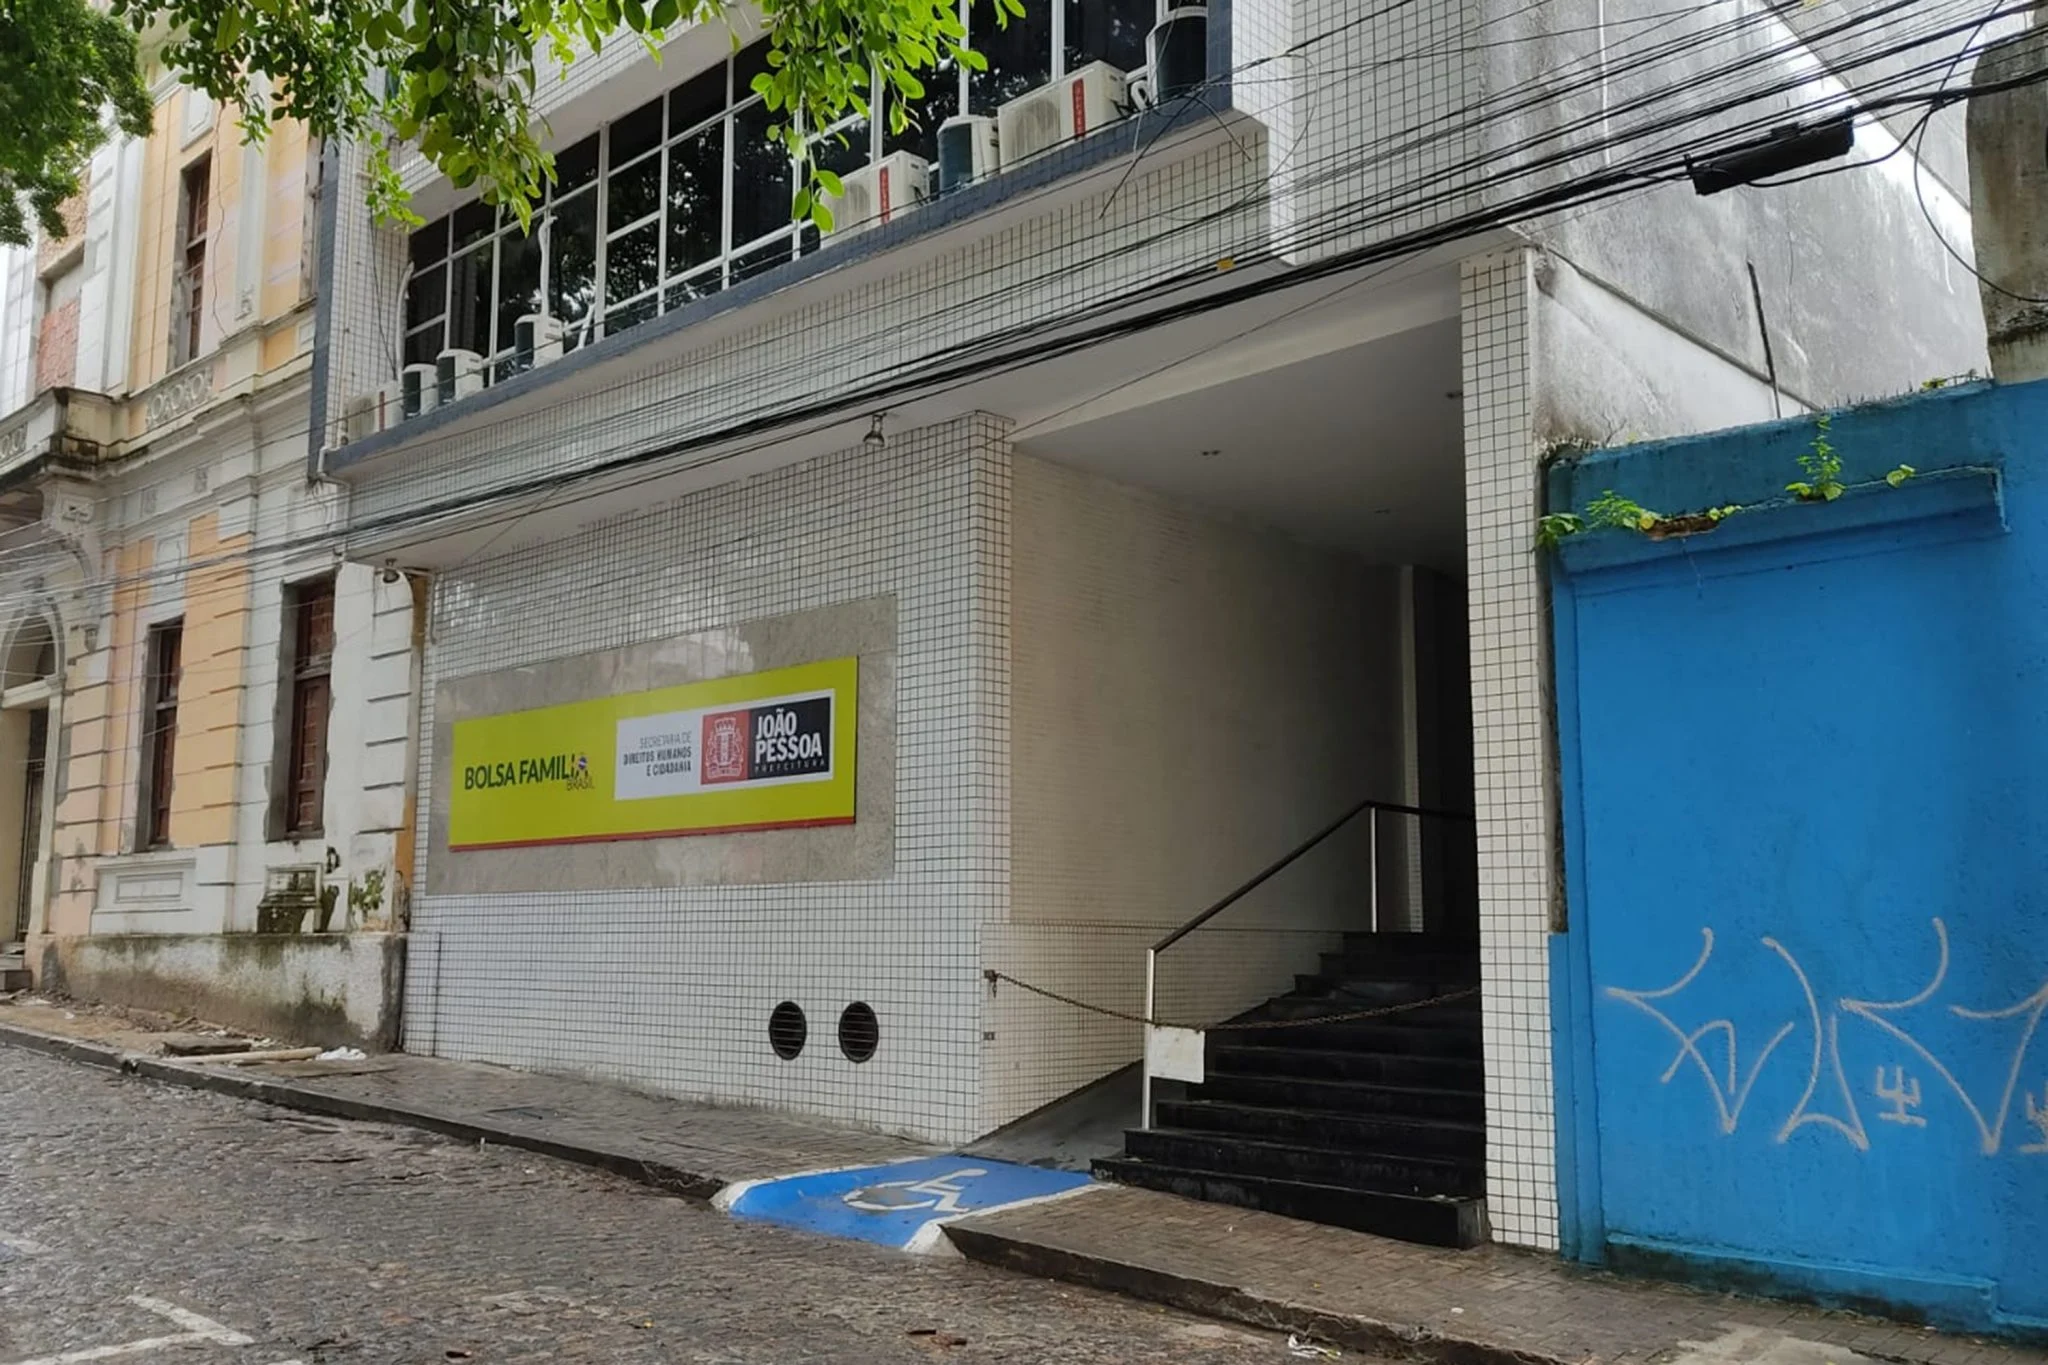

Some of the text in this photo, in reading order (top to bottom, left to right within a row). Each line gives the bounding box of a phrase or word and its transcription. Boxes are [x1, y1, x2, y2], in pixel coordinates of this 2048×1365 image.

[755, 708, 797, 739] JOÃO
[755, 732, 822, 764] PESSOA
[464, 762, 516, 790] BOLSA
